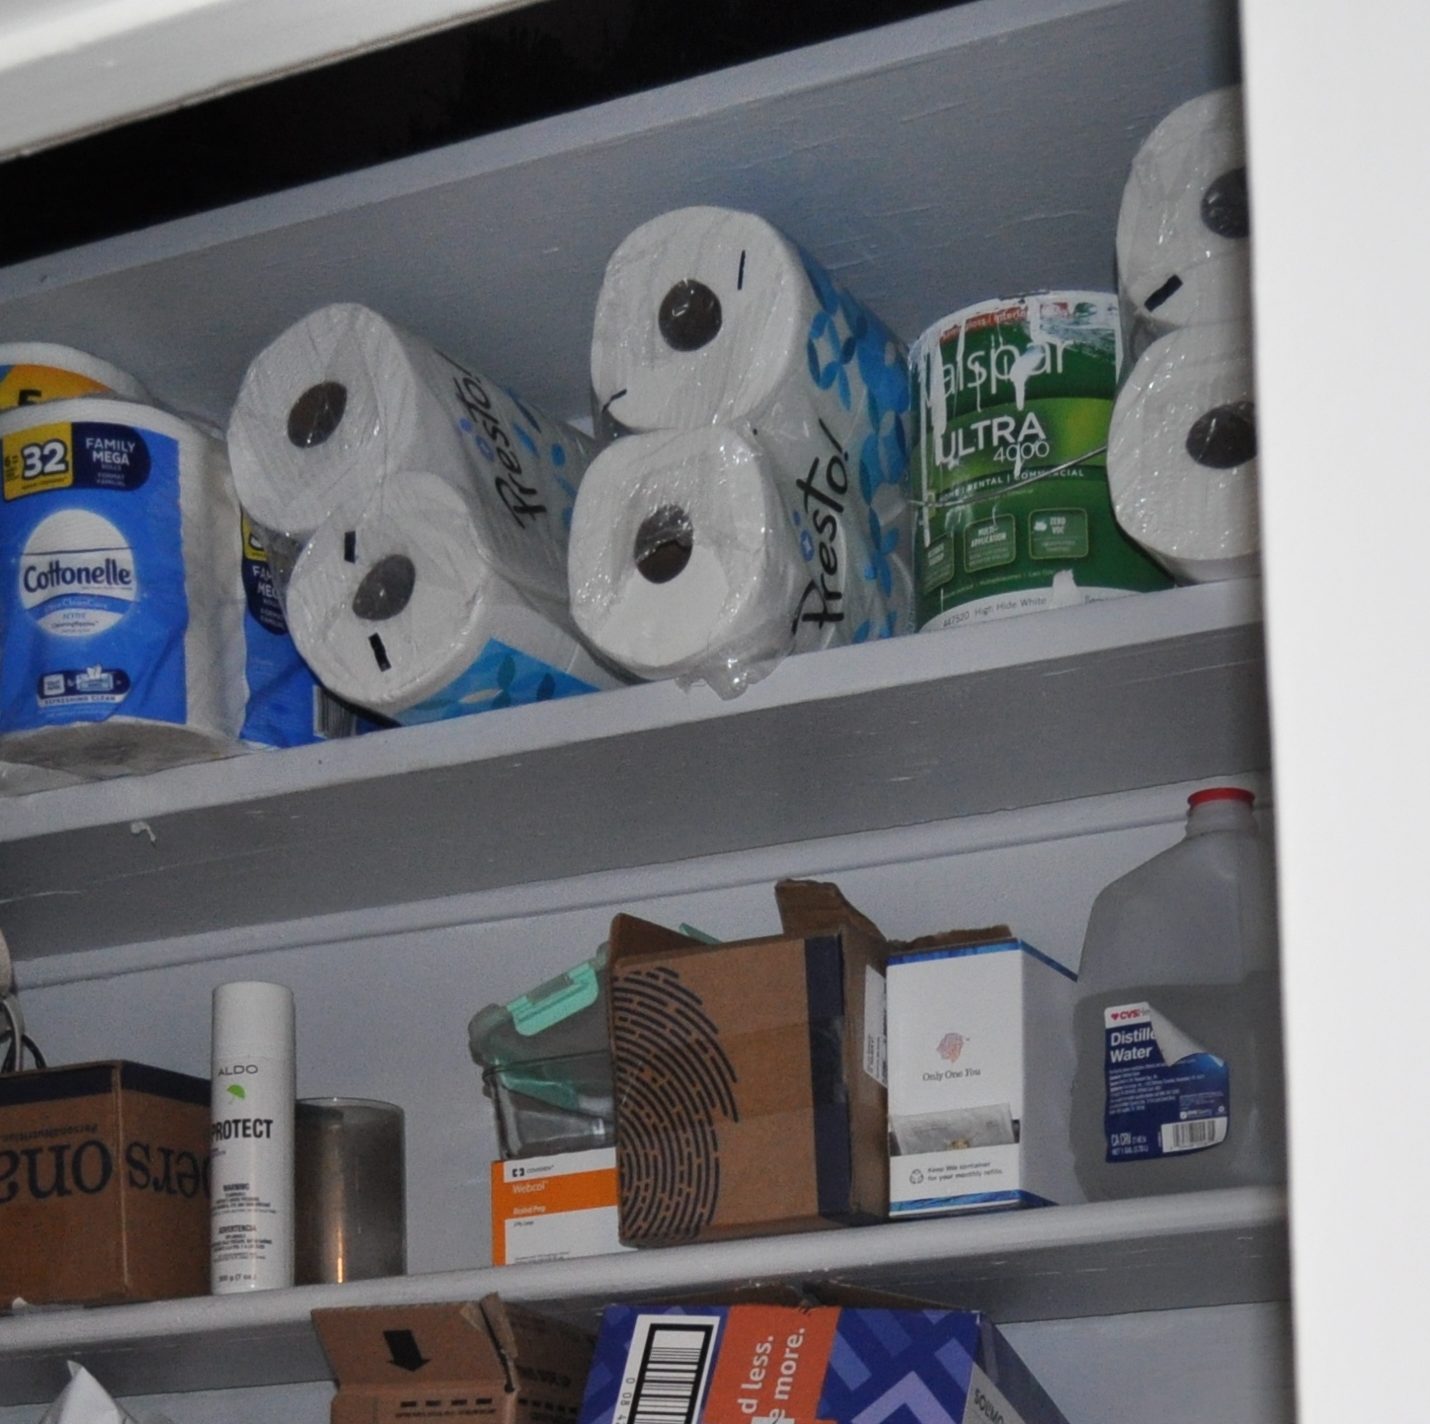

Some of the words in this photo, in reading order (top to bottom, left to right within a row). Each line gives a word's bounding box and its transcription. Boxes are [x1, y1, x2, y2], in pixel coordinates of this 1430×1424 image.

[942, 339, 1074, 399] alspar
[85, 437, 136, 453] FAMILY
[937, 411, 1047, 463] ULTRA
[21, 439, 69, 481] 32
[92, 450, 130, 466] MEGA
[992, 440, 1051, 464] 4000
[23, 558, 133, 594] Cottonelle
[1110, 1027, 1156, 1047] Distill
[1110, 1045, 1153, 1063] Water
[218, 1064, 259, 1077] ALDO
[922, 1070, 944, 1082] Only
[944, 1069, 963, 1080] One
[965, 1067, 981, 1077] You
[210, 1117, 274, 1142] PROTECT
[512, 1181, 546, 1194] Webcol
[927, 1174, 937, 1182] for
[739, 1335, 774, 1390] less.
[773, 1327, 806, 1401] more.
